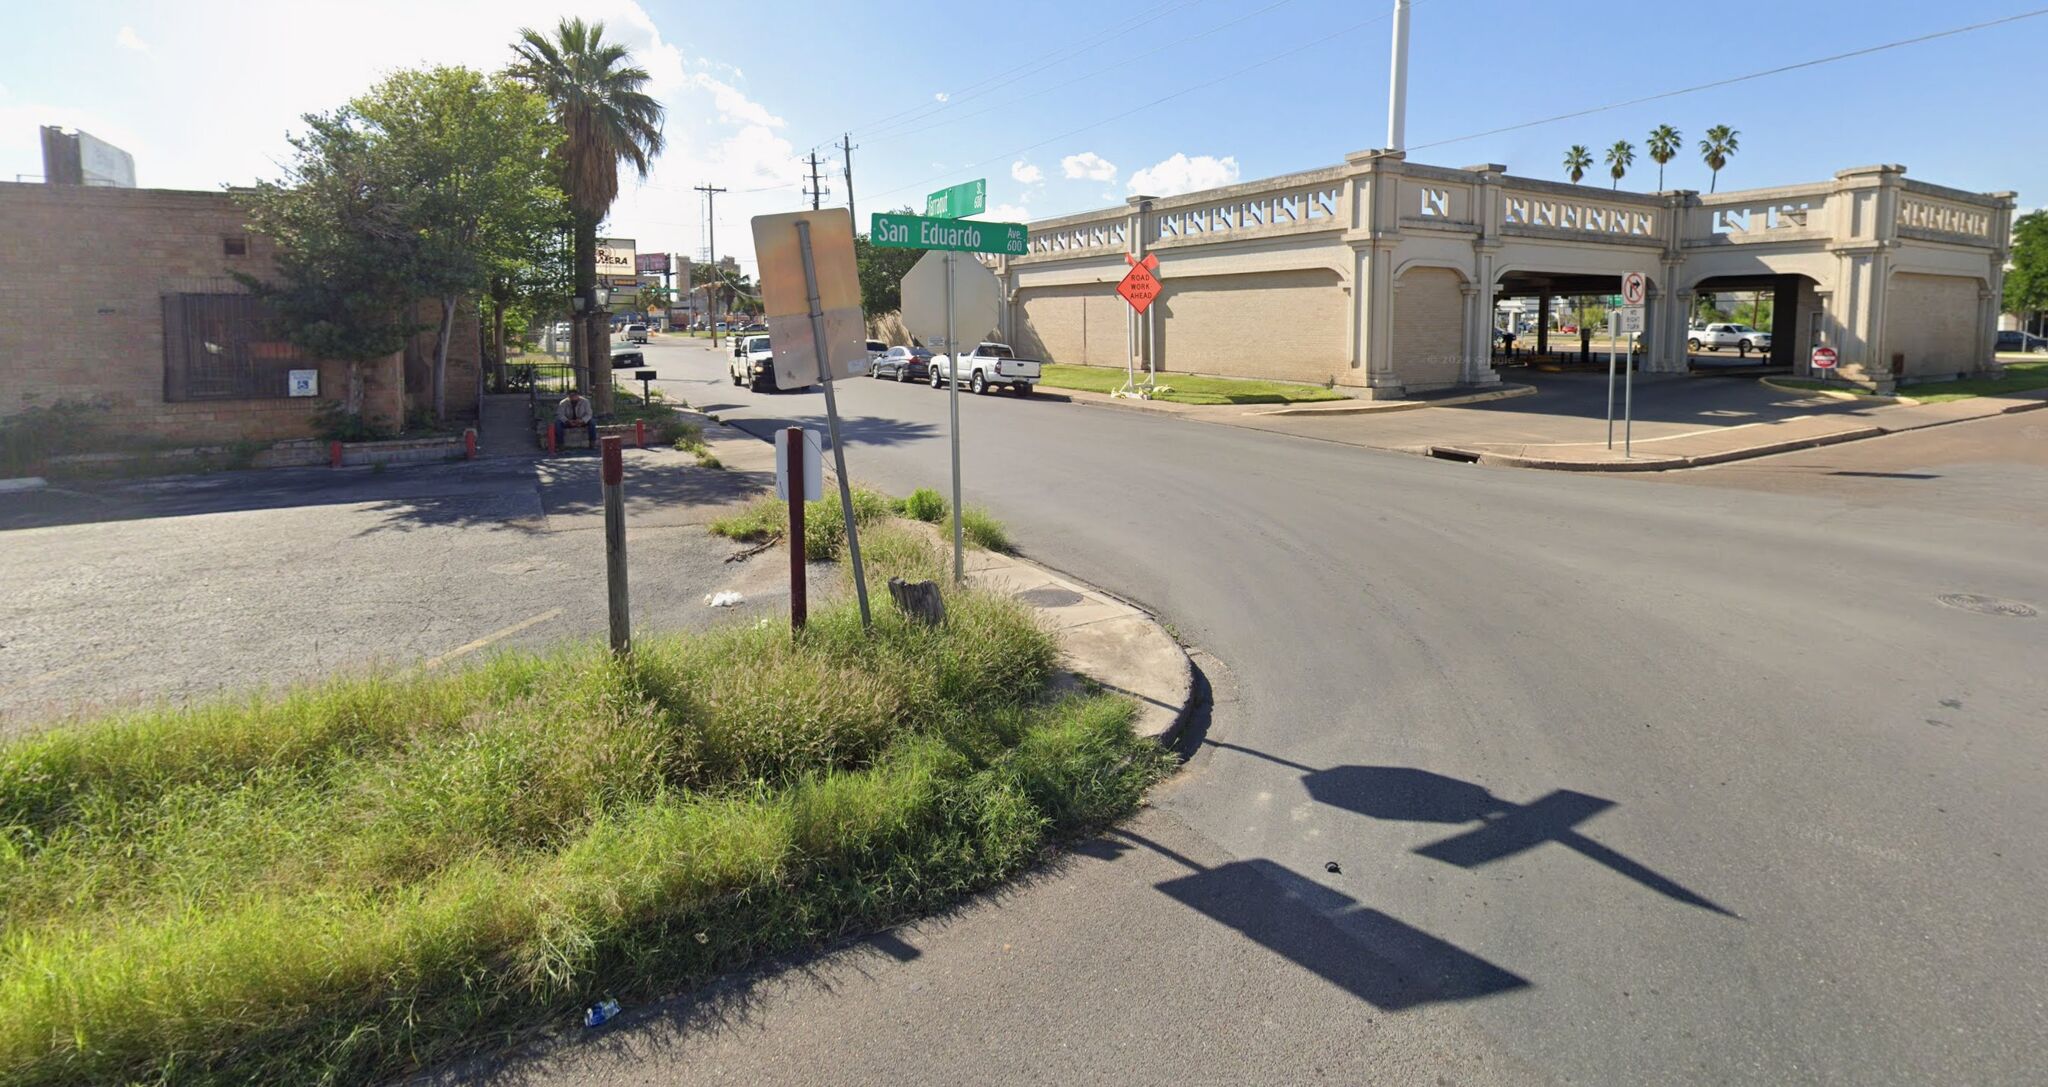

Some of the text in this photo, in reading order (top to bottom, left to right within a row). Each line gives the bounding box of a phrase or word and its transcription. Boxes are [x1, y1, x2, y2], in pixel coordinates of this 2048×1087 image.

[878, 218, 981, 248] San Eduardo
[1006, 240, 1022, 252] 600
